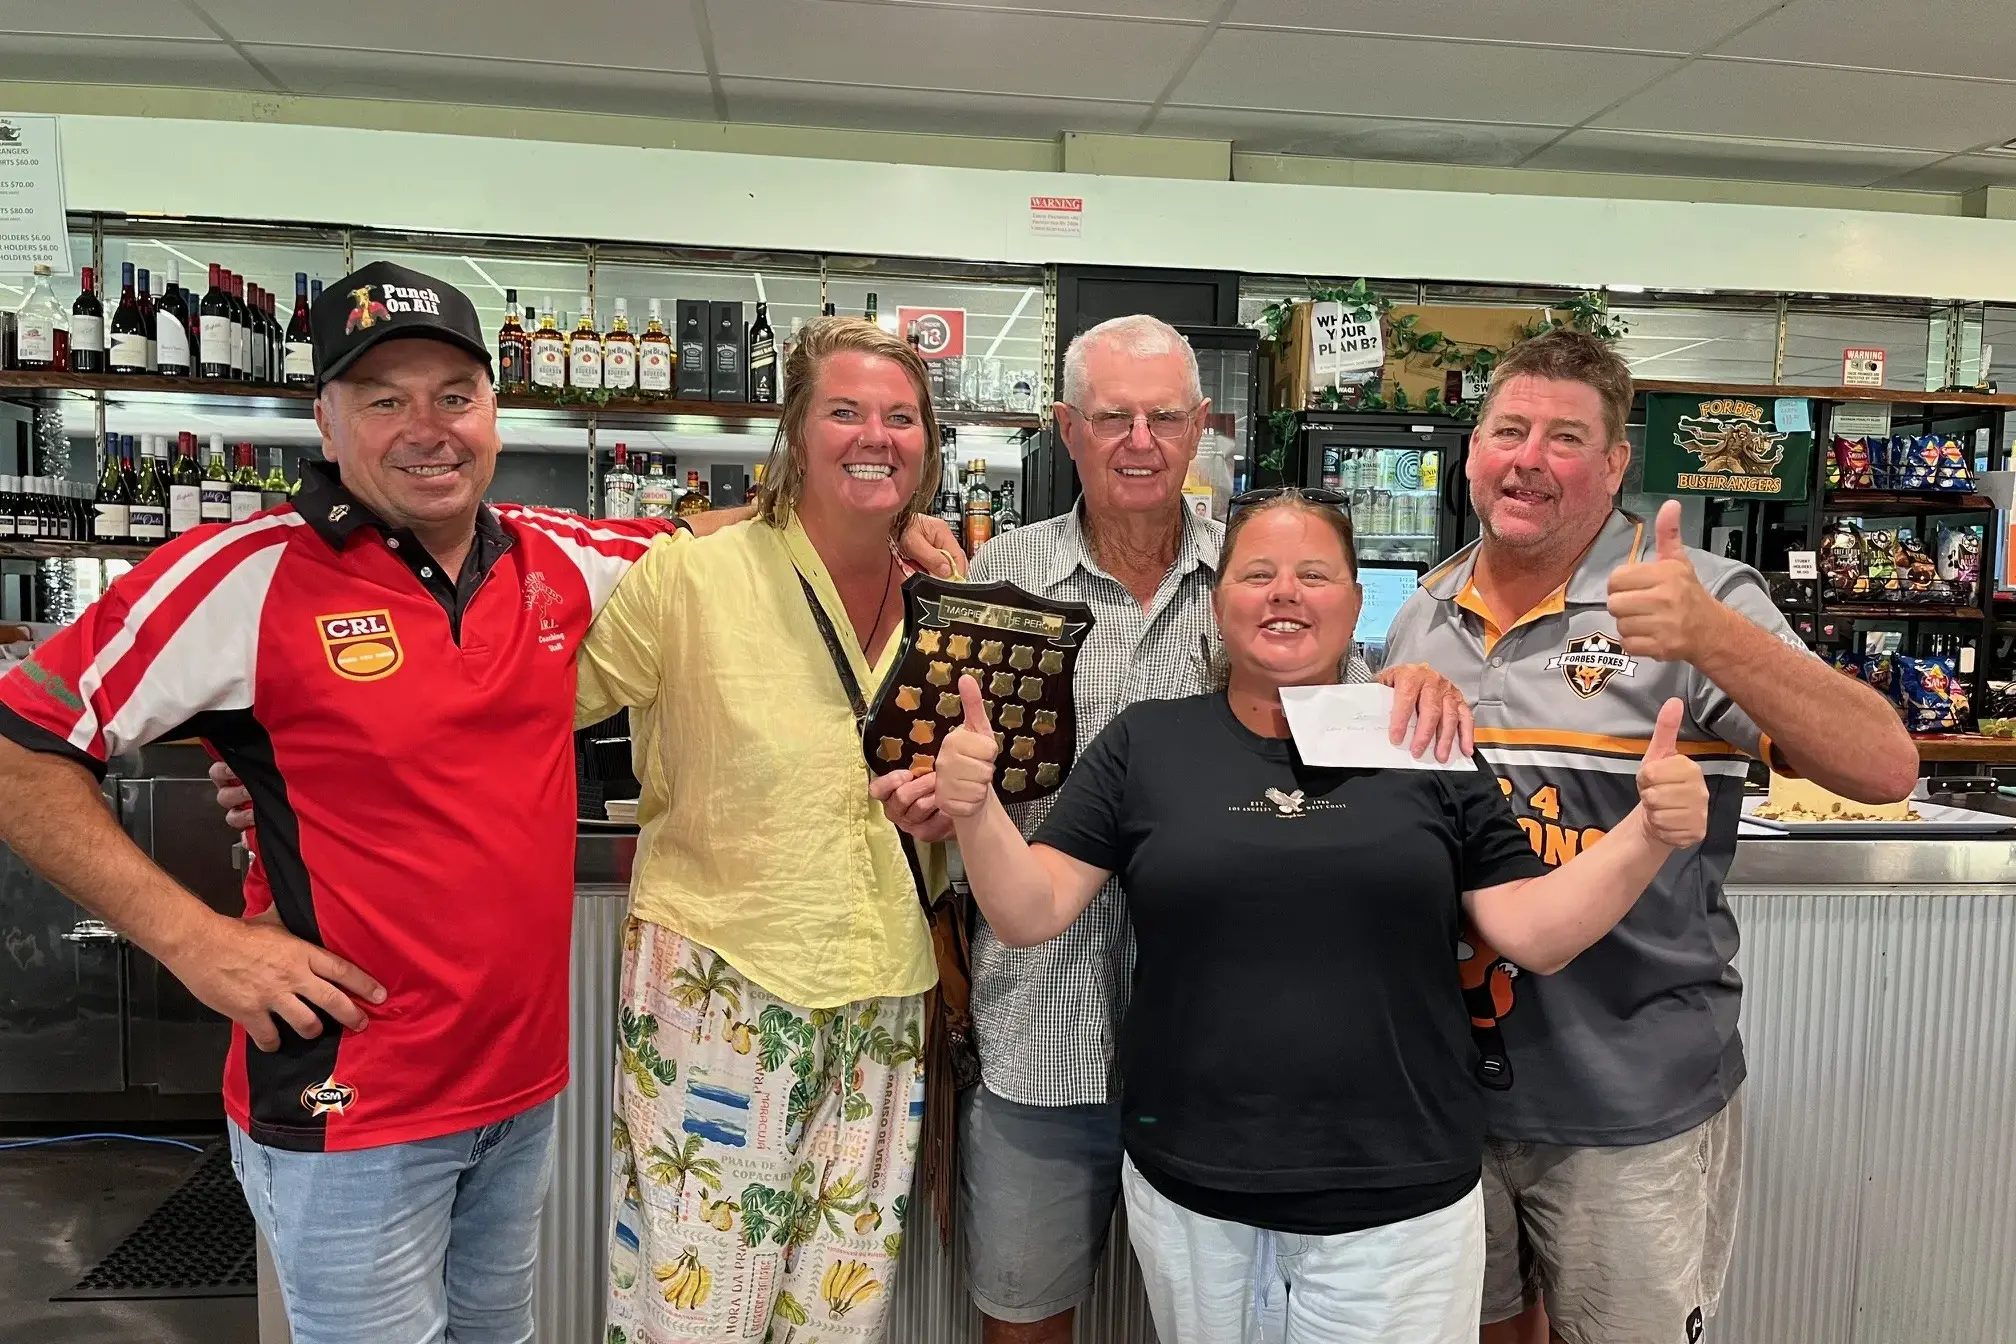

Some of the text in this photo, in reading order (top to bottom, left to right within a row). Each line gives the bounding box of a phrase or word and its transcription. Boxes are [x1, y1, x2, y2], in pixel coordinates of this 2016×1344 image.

[1031, 197, 1080, 209] WARNING
[382, 284, 441, 304] Punch
[386, 299, 440, 315] On Ali
[920, 328, 941, 346] 18
[1318, 337, 1378, 355] PLAN B?
[1847, 350, 1883, 360] WARNING
[1473, 383, 1490, 393] SW
[1699, 400, 1764, 421] FORBES
[1677, 473, 1782, 493] BUSHRANGERS
[327, 616, 387, 638] CRL
[1003, 614, 1022, 626] THE
[1564, 655, 1625, 668] FORBES FOXES
[1529, 785, 1560, 820] 4
[316, 1091, 341, 1101] CSM
[755, 1092, 771, 1152] MARACUJÁ
[871, 1074, 894, 1189] PARAISO DE VERÃO
[721, 1155, 777, 1171] PRAIA DE
[731, 1274, 744, 1293] DA
[725, 1297, 742, 1334] HORA
